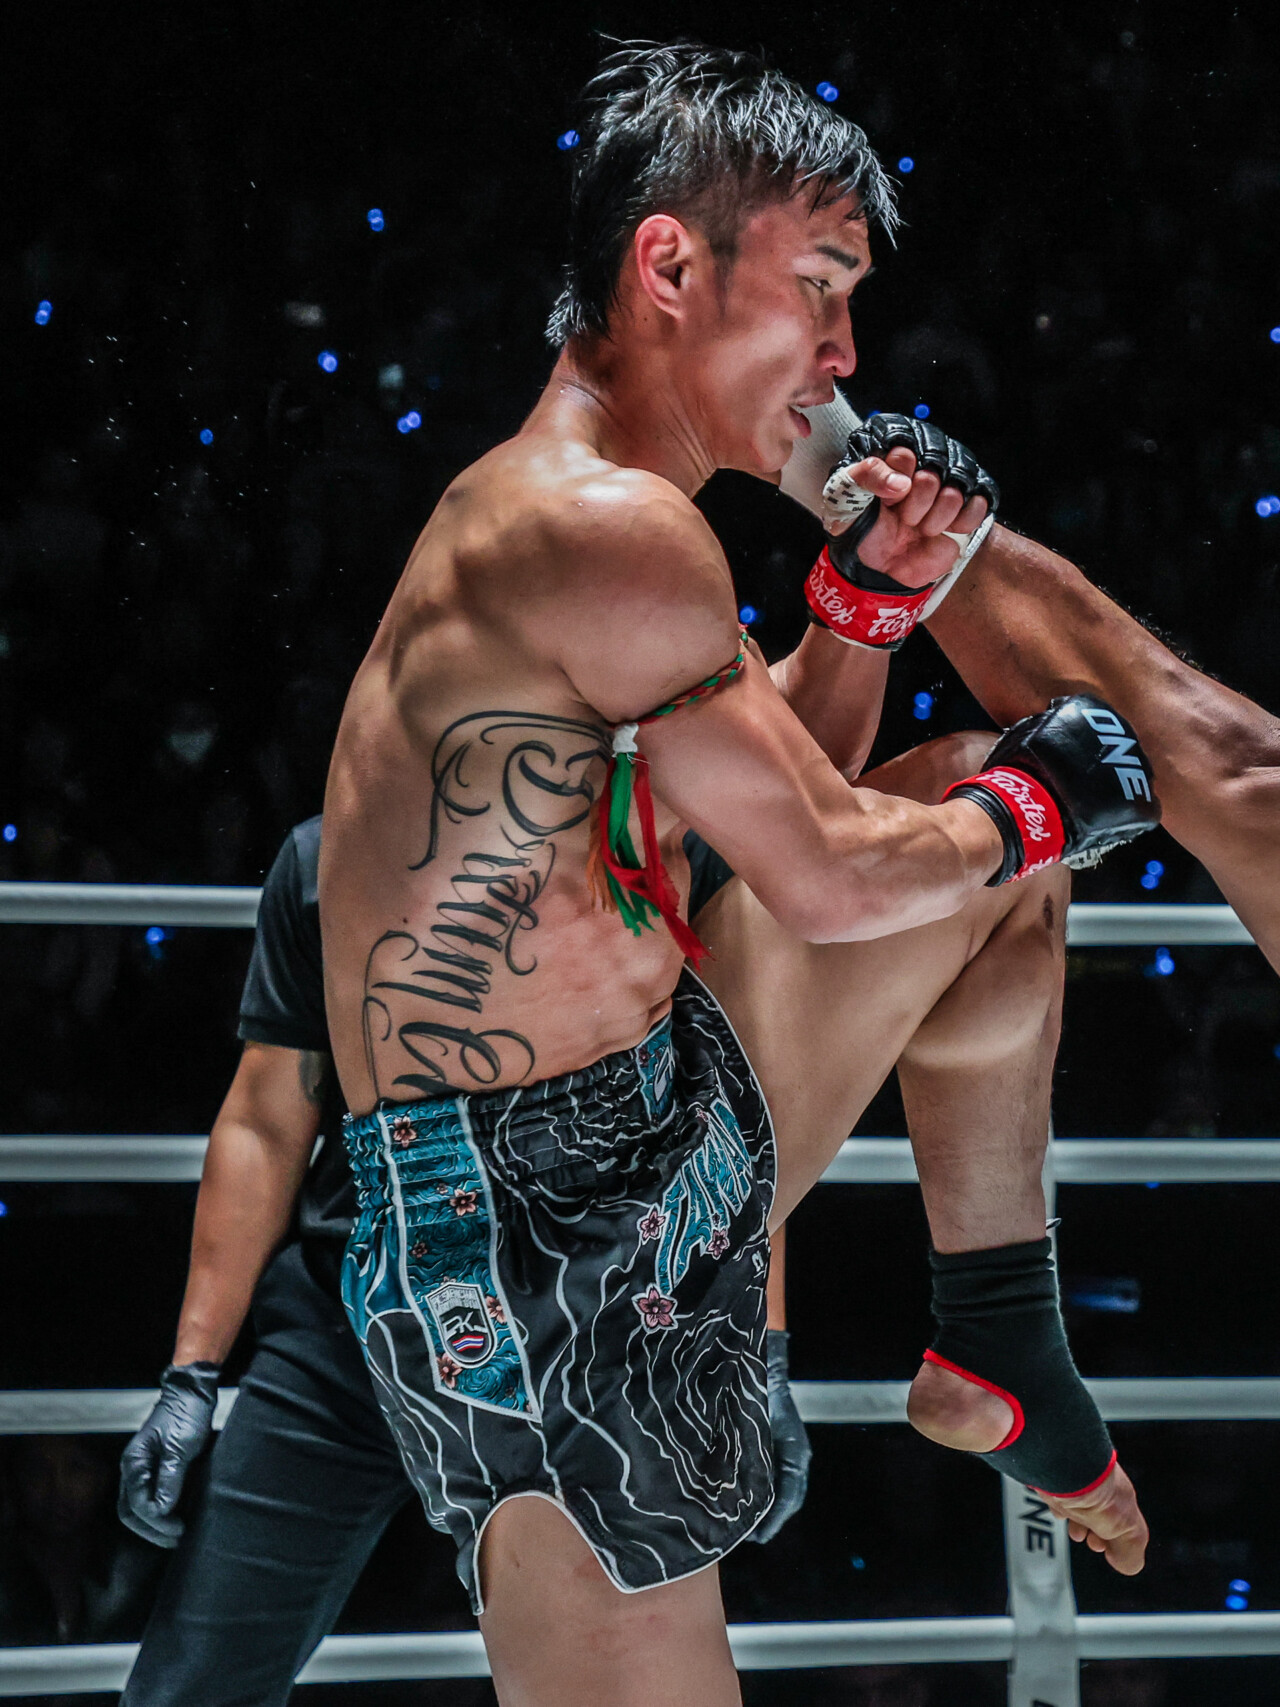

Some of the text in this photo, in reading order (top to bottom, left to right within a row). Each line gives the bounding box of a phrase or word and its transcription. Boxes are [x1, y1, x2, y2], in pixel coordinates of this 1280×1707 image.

[1080, 708, 1152, 803] ONE
[975, 770, 1052, 842] Fairtex
[1018, 1485, 1056, 1560] NE
